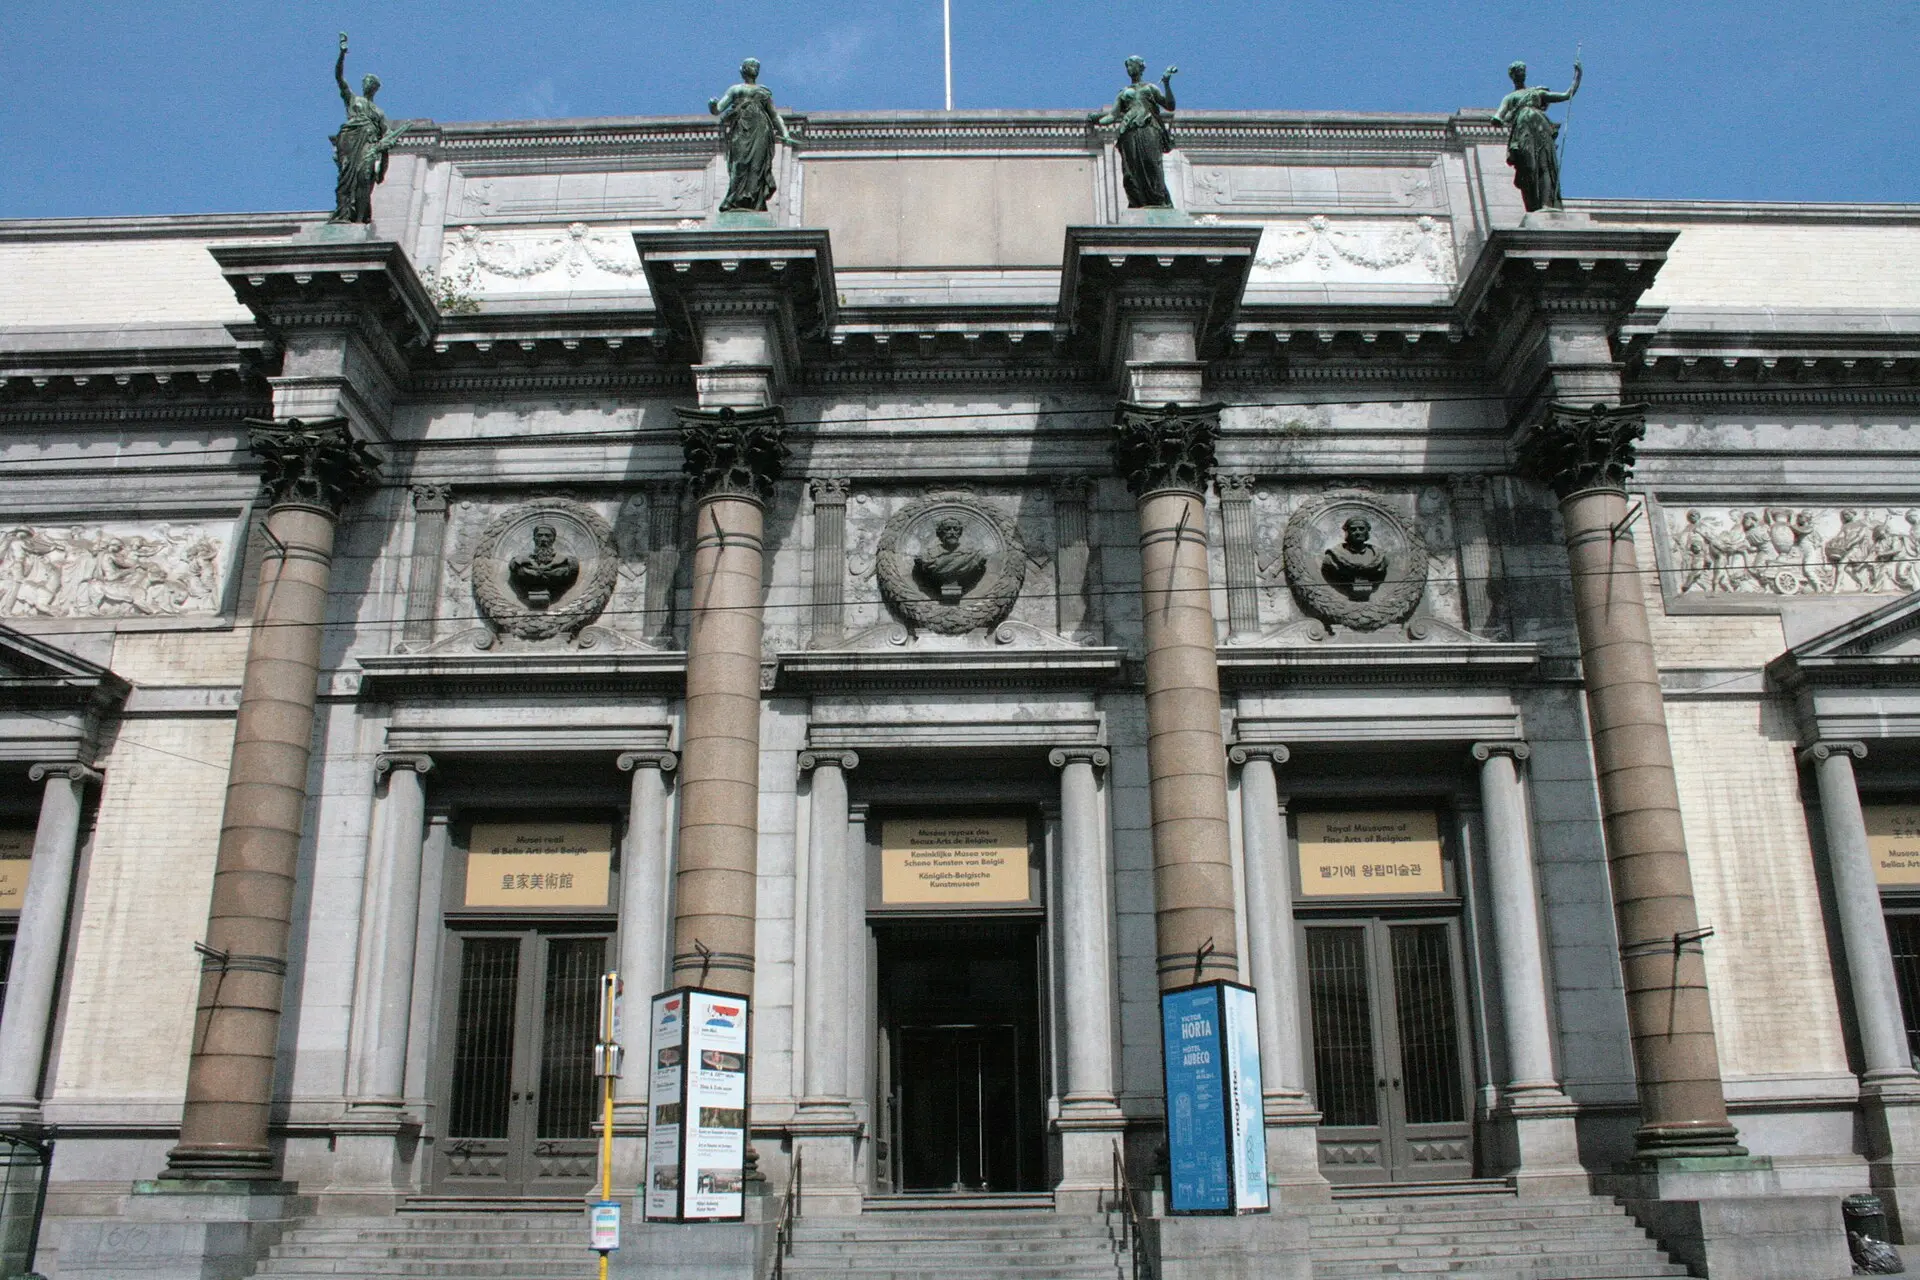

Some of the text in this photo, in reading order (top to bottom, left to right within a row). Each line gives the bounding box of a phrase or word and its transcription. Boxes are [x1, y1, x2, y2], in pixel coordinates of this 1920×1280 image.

[1326, 823, 1406, 834] Royal Museums of
[545, 835, 564, 844] reali
[1344, 835, 1361, 843] Arts
[1365, 834, 1373, 842] of
[1376, 835, 1411, 844] Belgium
[911, 851, 952, 859] Koninklijke
[1362, 863, 1421, 877] 왕립미술관
[1881, 860, 1905, 869] Bellas
[501, 873, 574, 890] 皇家美術館
[1182, 1019, 1212, 1040] HORTA
[1183, 1051, 1210, 1067] AUBECQ
[1233, 1069, 1241, 1137] magritte
